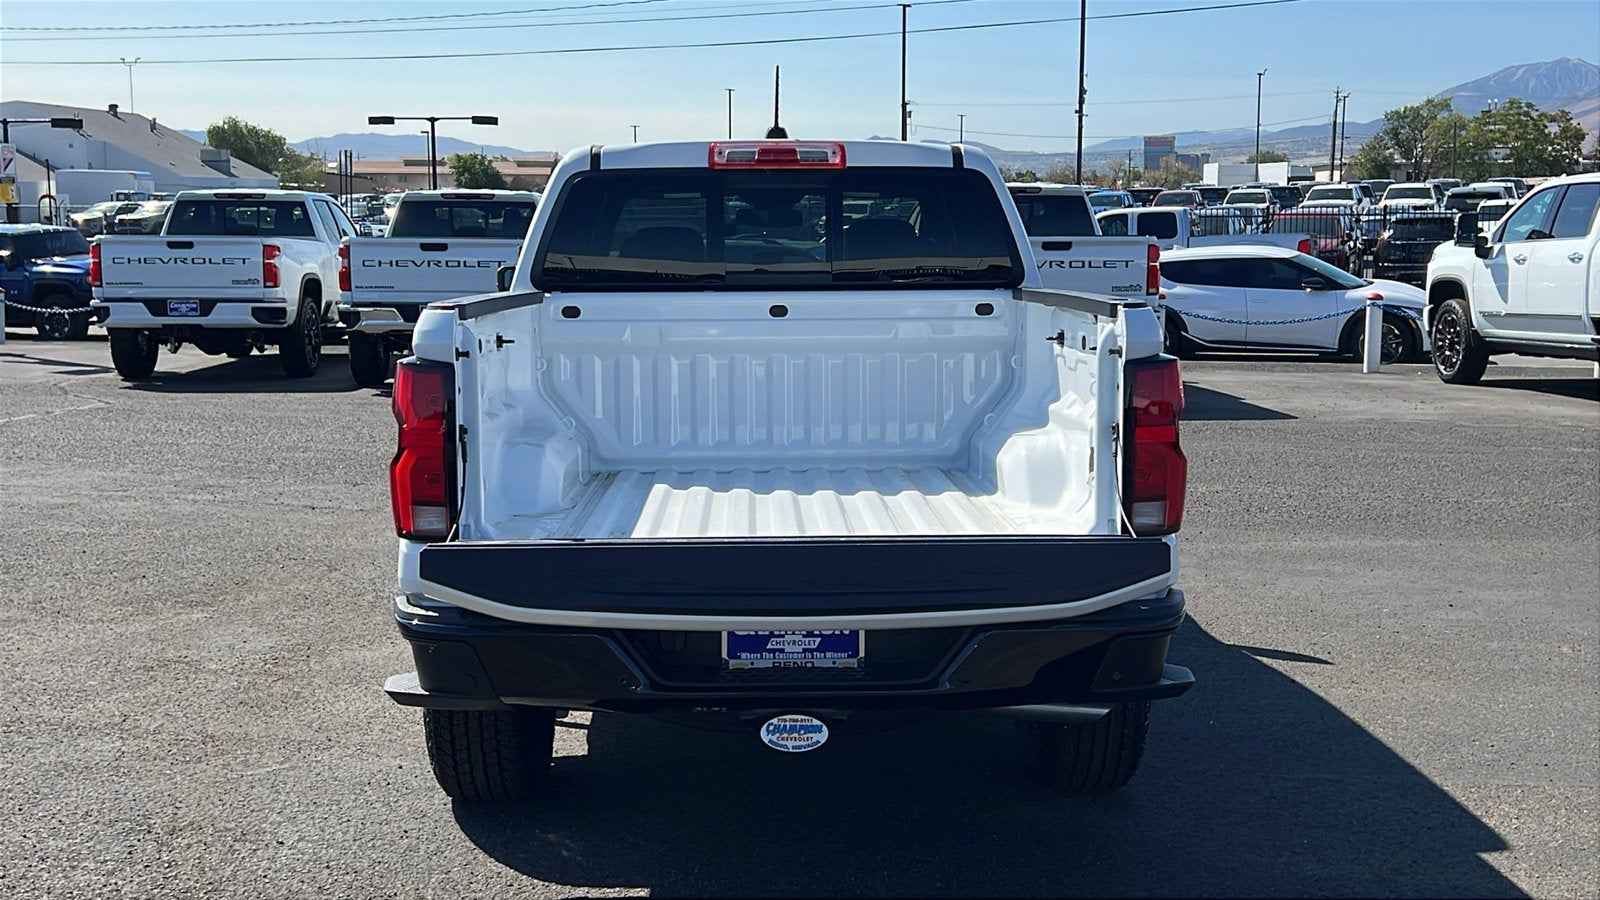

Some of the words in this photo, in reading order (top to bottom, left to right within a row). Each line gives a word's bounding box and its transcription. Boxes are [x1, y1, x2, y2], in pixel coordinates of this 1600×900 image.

[112, 257, 251, 265] CHEVROLET
[362, 259, 507, 268] CHEVROLET
[1037, 260, 1135, 269] VROLET
[791, 739, 822, 751] NEVADA
